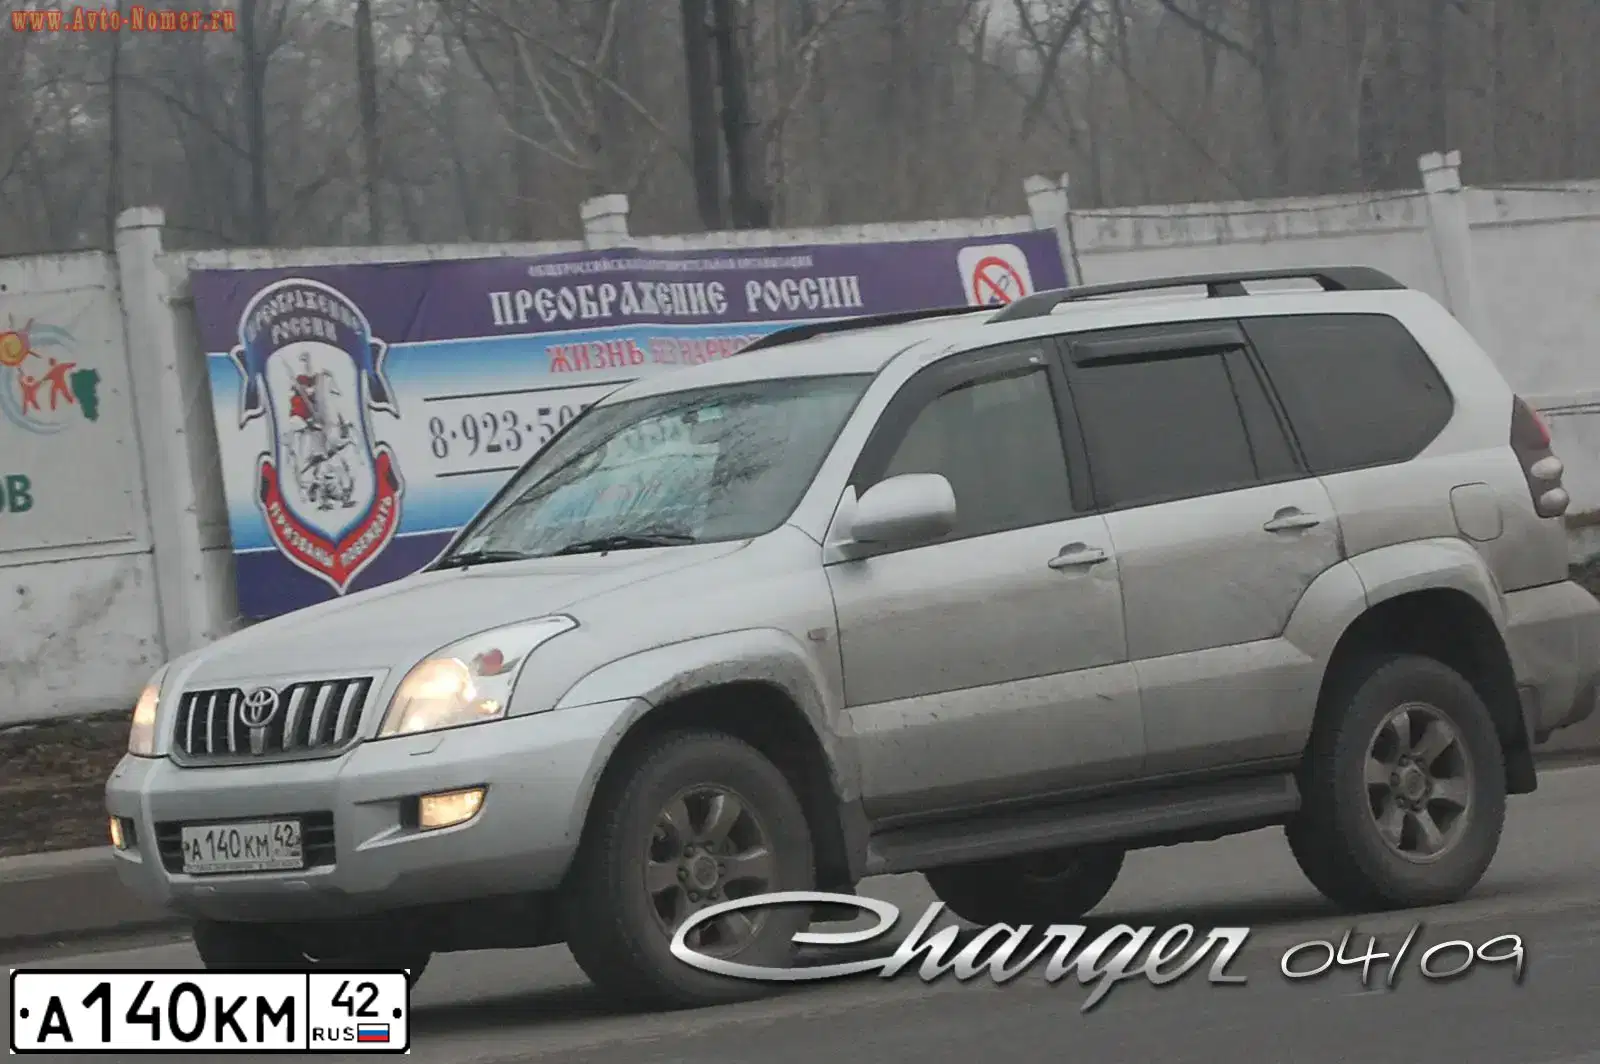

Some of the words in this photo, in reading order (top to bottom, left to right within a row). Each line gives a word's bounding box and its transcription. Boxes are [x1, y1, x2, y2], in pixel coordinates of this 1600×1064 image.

[490, 280, 727, 325] ПРЕОБРАЖЕНИЕ
[745, 275, 863, 313] РОССИИ
[546, 337, 644, 373] ЖИЗНЬ
[0, 474, 34, 513] В
[274, 824, 294, 848] 42
